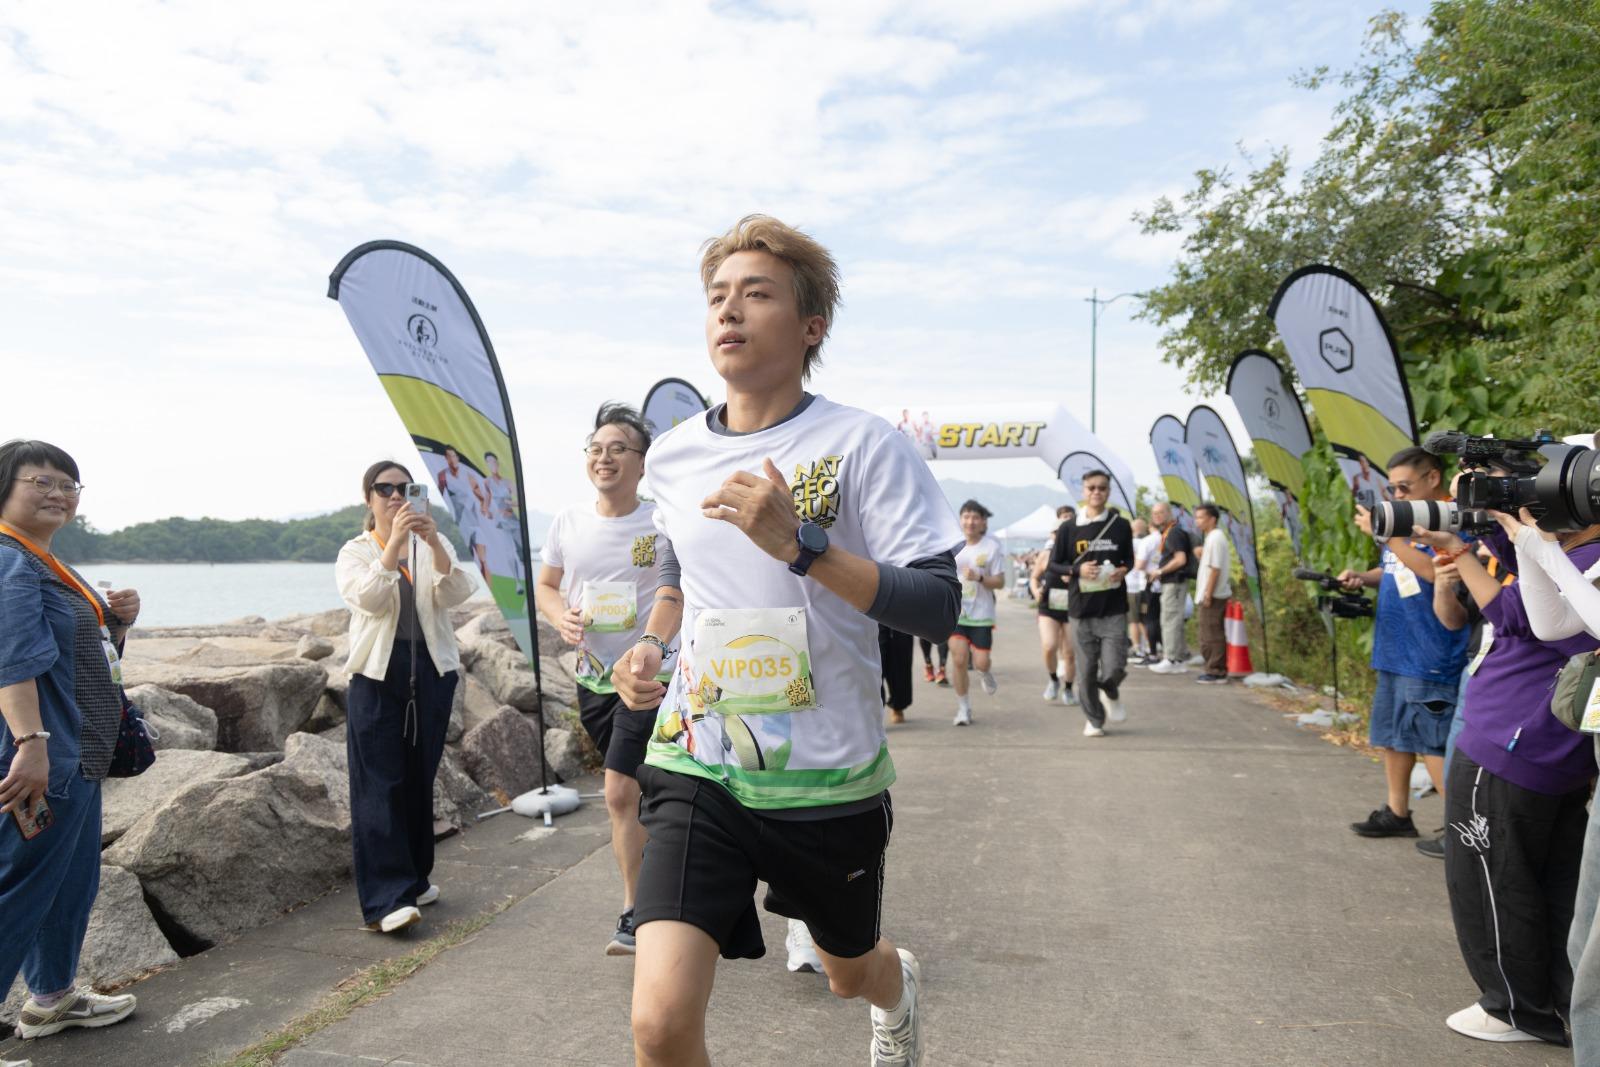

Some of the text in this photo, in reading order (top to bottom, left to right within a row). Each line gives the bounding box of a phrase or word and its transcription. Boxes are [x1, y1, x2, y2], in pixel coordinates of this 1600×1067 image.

[938, 422, 1047, 448] START
[795, 456, 844, 481] NAT
[790, 476, 839, 501] GEO
[794, 493, 840, 522] RUN
[710, 656, 793, 679] VIP035
